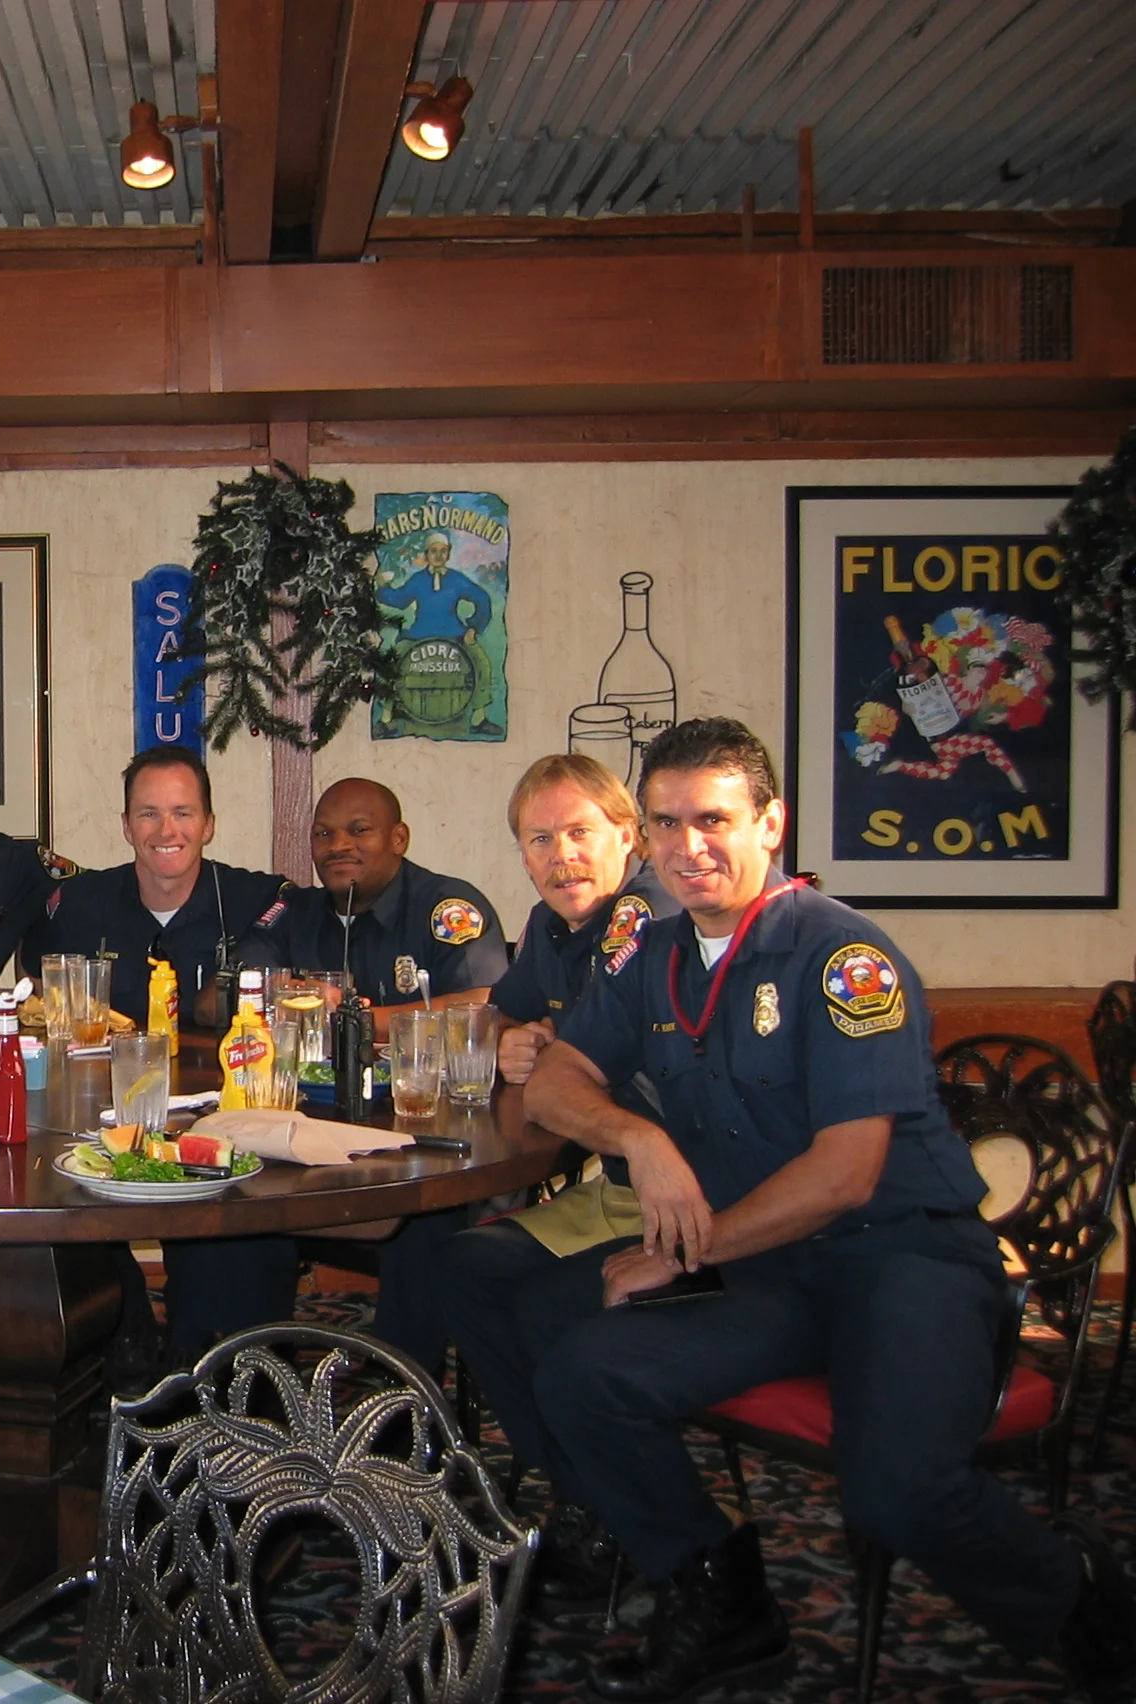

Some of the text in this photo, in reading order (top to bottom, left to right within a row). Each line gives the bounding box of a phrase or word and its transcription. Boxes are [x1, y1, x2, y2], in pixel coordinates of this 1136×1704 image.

[426, 495, 453, 504] AU
[421, 505, 507, 545] NORMAND
[410, 644, 459, 662] CIDRE
[155, 591, 181, 742] SALU
[409, 662, 461, 673] MOUSSEUX
[901, 678, 937, 697] FLORIO
